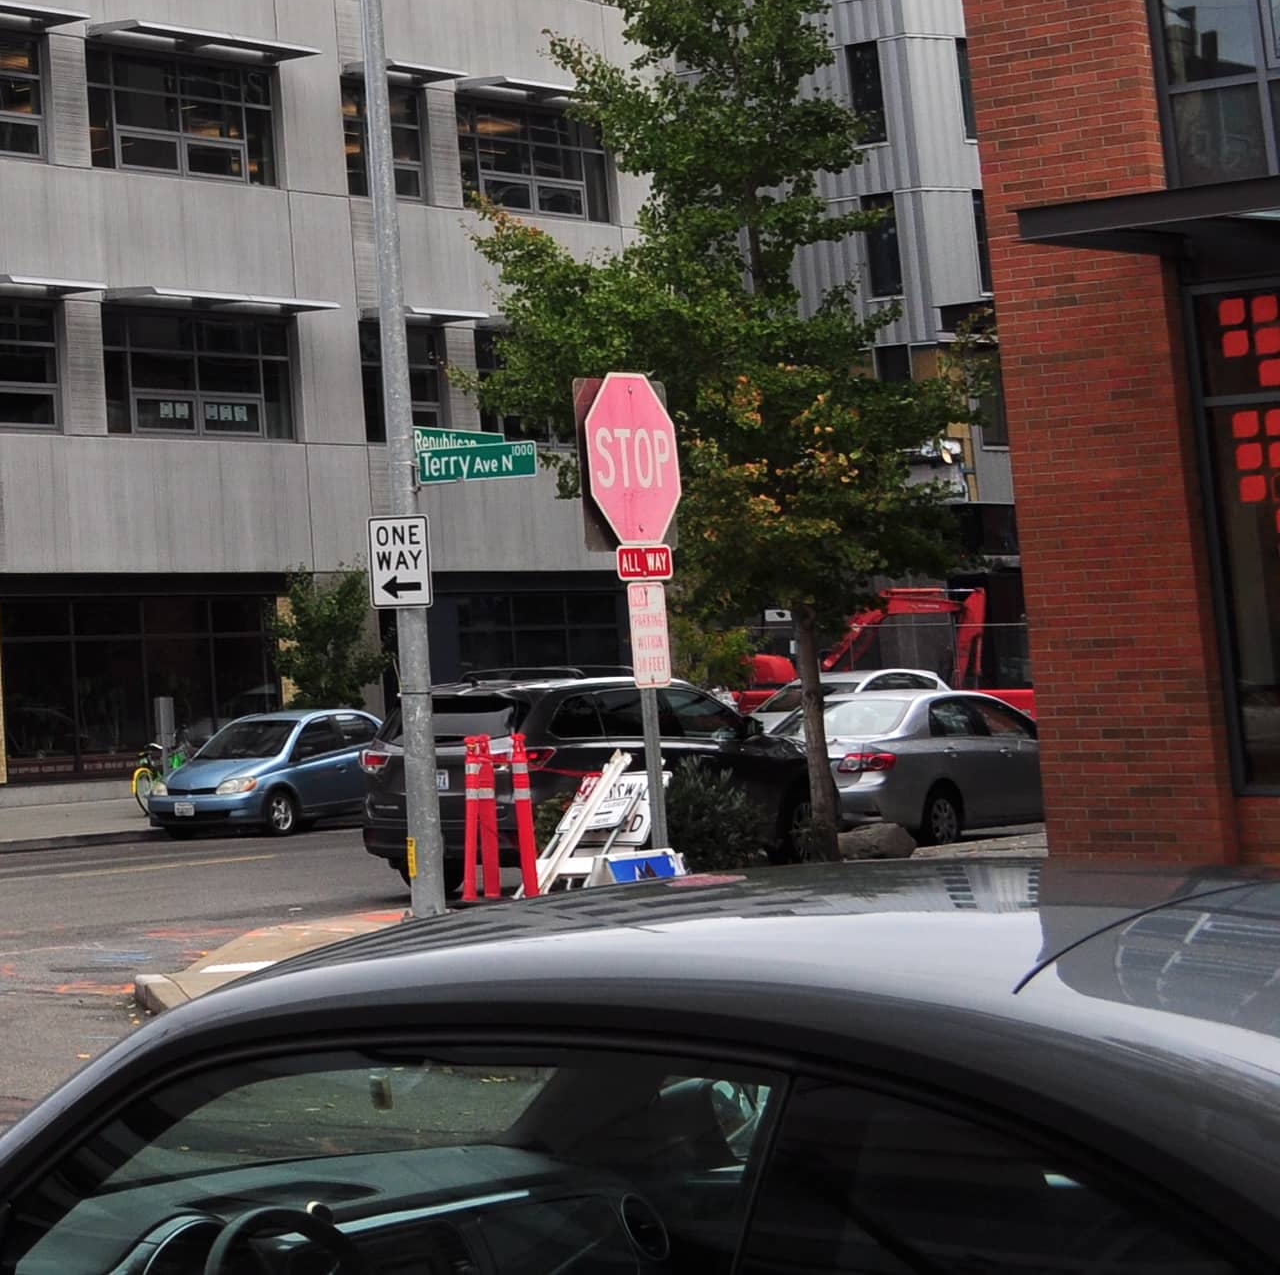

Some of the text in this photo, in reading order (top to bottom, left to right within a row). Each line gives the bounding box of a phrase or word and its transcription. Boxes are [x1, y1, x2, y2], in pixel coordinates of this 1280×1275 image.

[511, 444, 533, 457] 1000
[595, 427, 670, 488] STOP
[421, 452, 513, 479] Terry Ave N
[376, 525, 421, 547] ONE
[376, 549, 423, 572] WAY
[621, 552, 668, 573] ALL WAY
